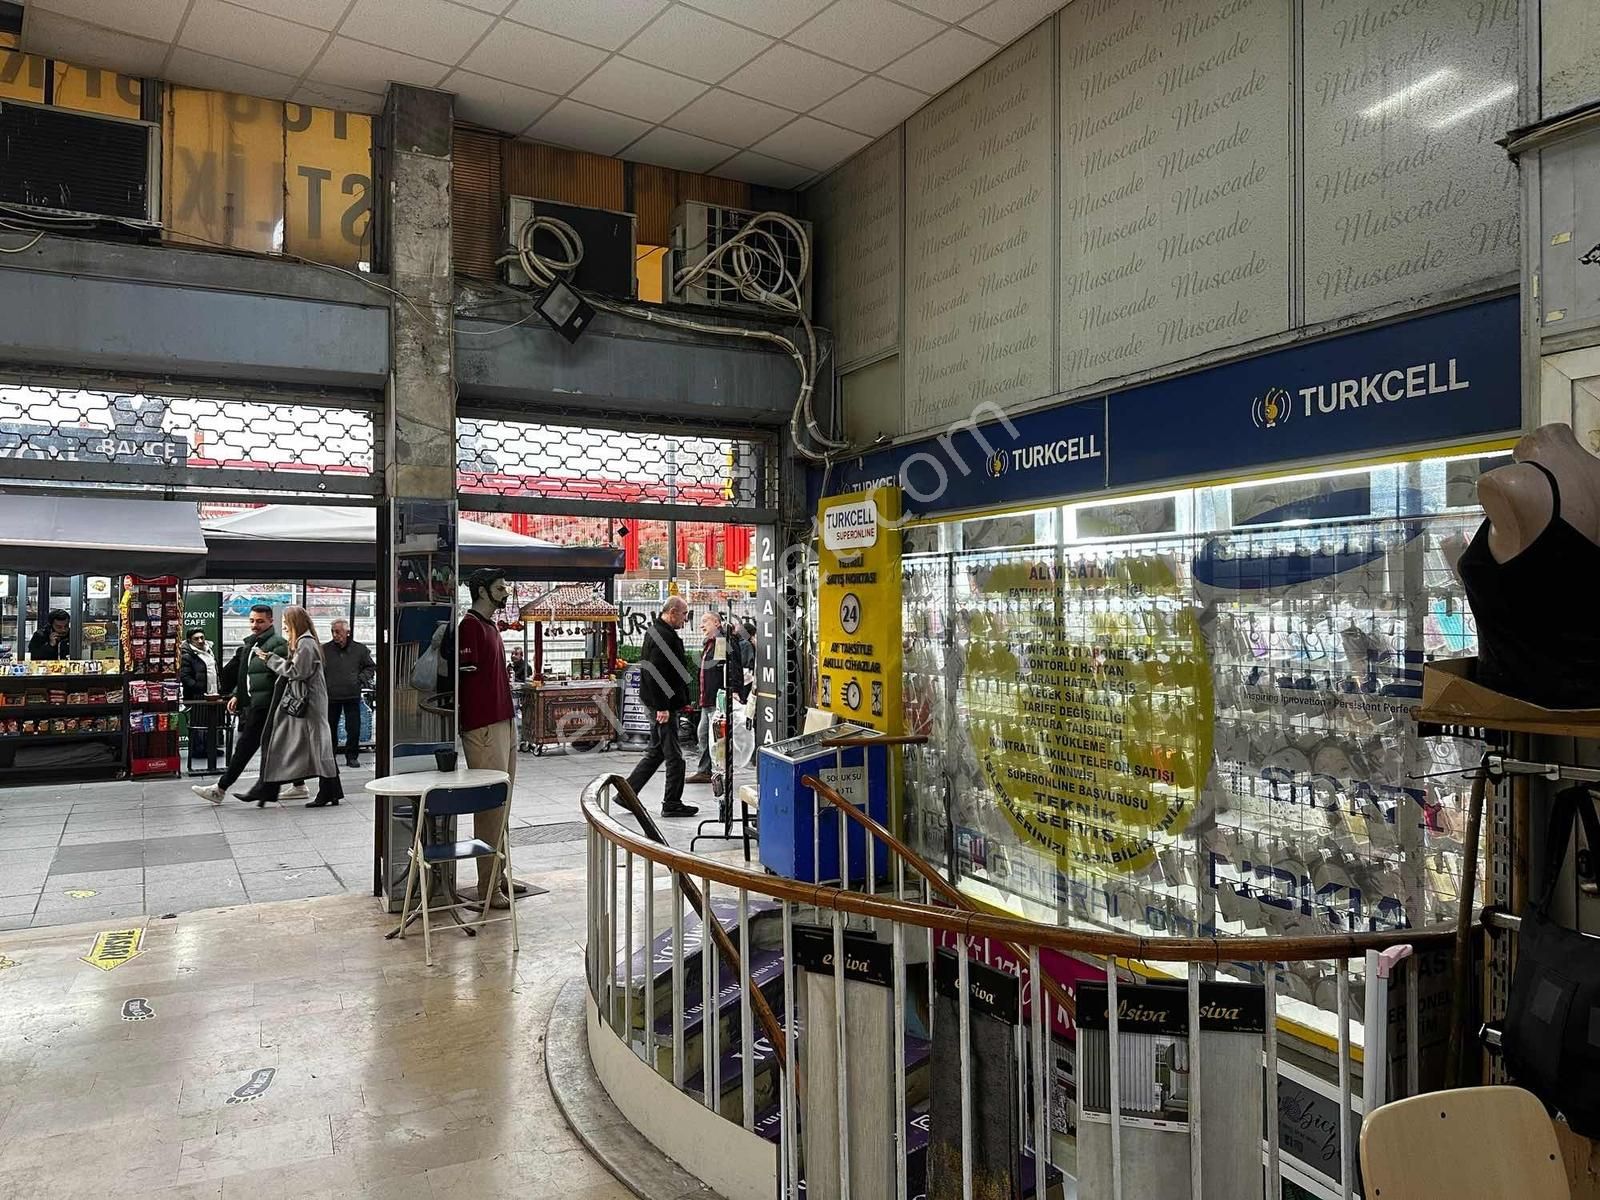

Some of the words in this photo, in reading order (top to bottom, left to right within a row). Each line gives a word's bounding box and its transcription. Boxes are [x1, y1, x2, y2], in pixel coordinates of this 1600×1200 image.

[1070, 9, 1145, 70] Muscade
[1081, 43, 1157, 101] Muscade
[1158, 31, 1249, 96] Muscade
[1070, 90, 1145, 145] Muscade
[1172, 67, 1266, 131] Muscade
[1080, 124, 1158, 178] Muscade
[1158, 121, 1249, 180] Muscade
[1315, 135, 1444, 203] Muscade
[1069, 171, 1145, 222] Muscade
[1172, 158, 1268, 216] Muscade
[1080, 205, 1158, 254] Muscade
[1335, 181, 1470, 246] Muscade
[1157, 210, 1250, 263] Muscade
[977, 255, 1039, 297] Muscade
[1068, 251, 1146, 298] Muscade
[1171, 250, 1266, 300] Muscade
[1315, 240, 1450, 299] Muscade
[1079, 287, 1158, 331] Muscade
[1156, 301, 1249, 346] Muscade
[1067, 333, 1146, 373] Muscade
[1299, 358, 1469, 417] TURKCELL
[1012, 434, 1101, 471] TURKCELL
[826, 508, 875, 530] TURKCELL
[836, 527, 875, 541] SUPERONLINE
[761, 537, 775, 562] 2.
[760, 569, 775, 588] EL
[1029, 566, 1063, 580] ALIM
[1069, 564, 1116, 579] SATIM
[842, 605, 857, 623] 24
[1015, 672, 1060, 686] FATURALI
[1063, 677, 1097, 689] HATTA
[1065, 691, 1084, 703] SİM
[1023, 701, 1056, 714] TARİFE
[1025, 716, 1063, 731] FATURA
[1243, 692, 1279, 704] Inspiring
[1383, 703, 1411, 715] Perfe
[1055, 734, 1106, 753] YÜKLEME
[1043, 747, 1077, 762] AKILLI
[1079, 754, 1130, 773] TELEFON
[1134, 764, 1176, 784] SATIŞI
[1033, 791, 1117, 824] TEKNİK
[1078, 784, 1149, 811] BAŞVURUSU
[822, 953, 870, 973] eiva
[954, 978, 995, 1005] esiva
[1104, 999, 1168, 1023] lsiva
